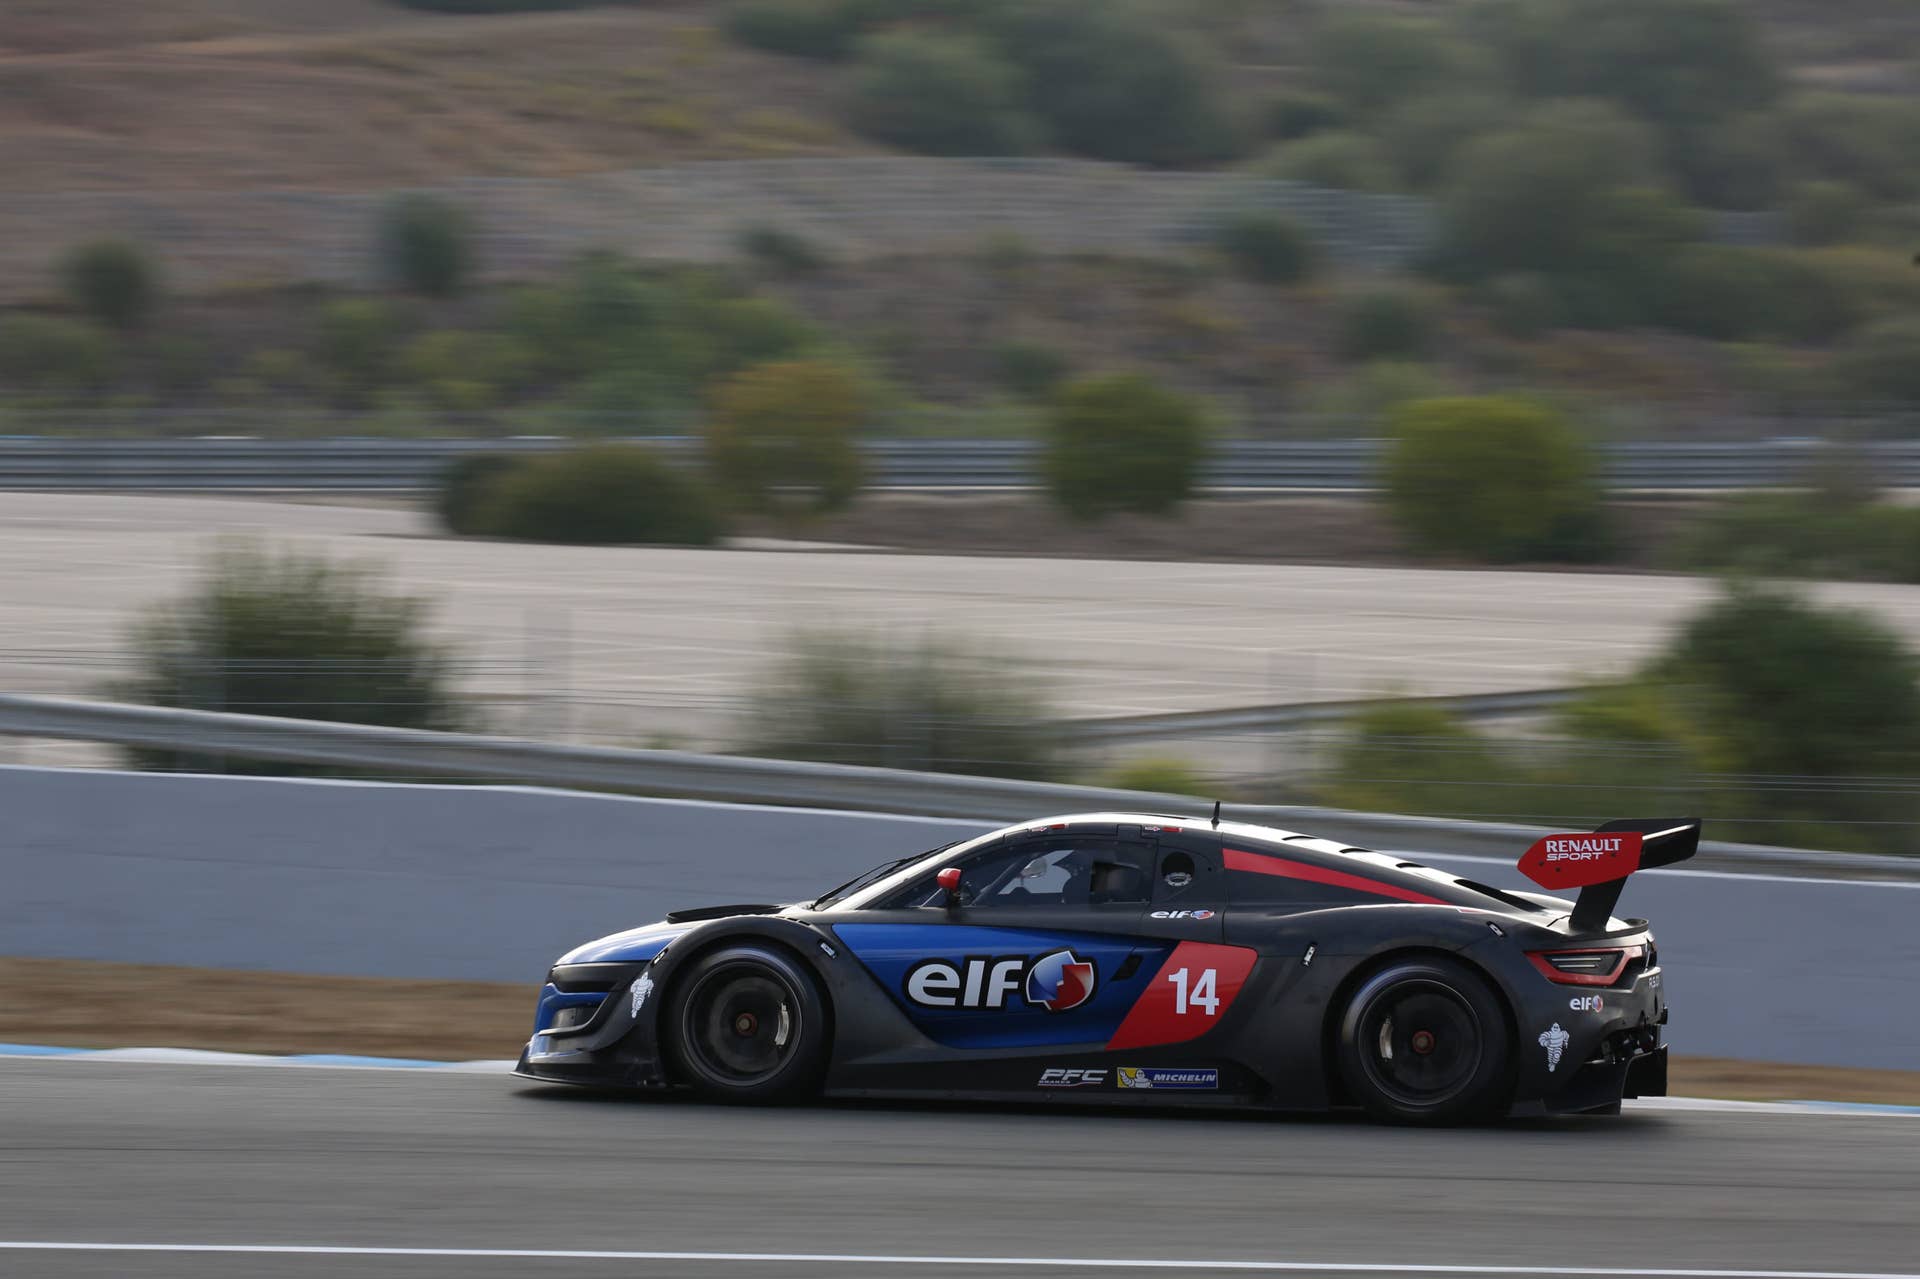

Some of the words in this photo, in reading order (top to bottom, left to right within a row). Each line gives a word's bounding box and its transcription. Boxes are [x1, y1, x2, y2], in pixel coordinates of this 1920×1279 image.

[1545, 838, 1622, 853] RENAULT
[1546, 852, 1604, 861] SPORT
[1150, 910, 1191, 919] elf
[908, 960, 1023, 1006] elf
[1168, 967, 1220, 1015] 14
[1569, 996, 1592, 1010] elf
[1040, 1068, 1108, 1081] PFC
[1153, 1073, 1216, 1082] MICHELIN
